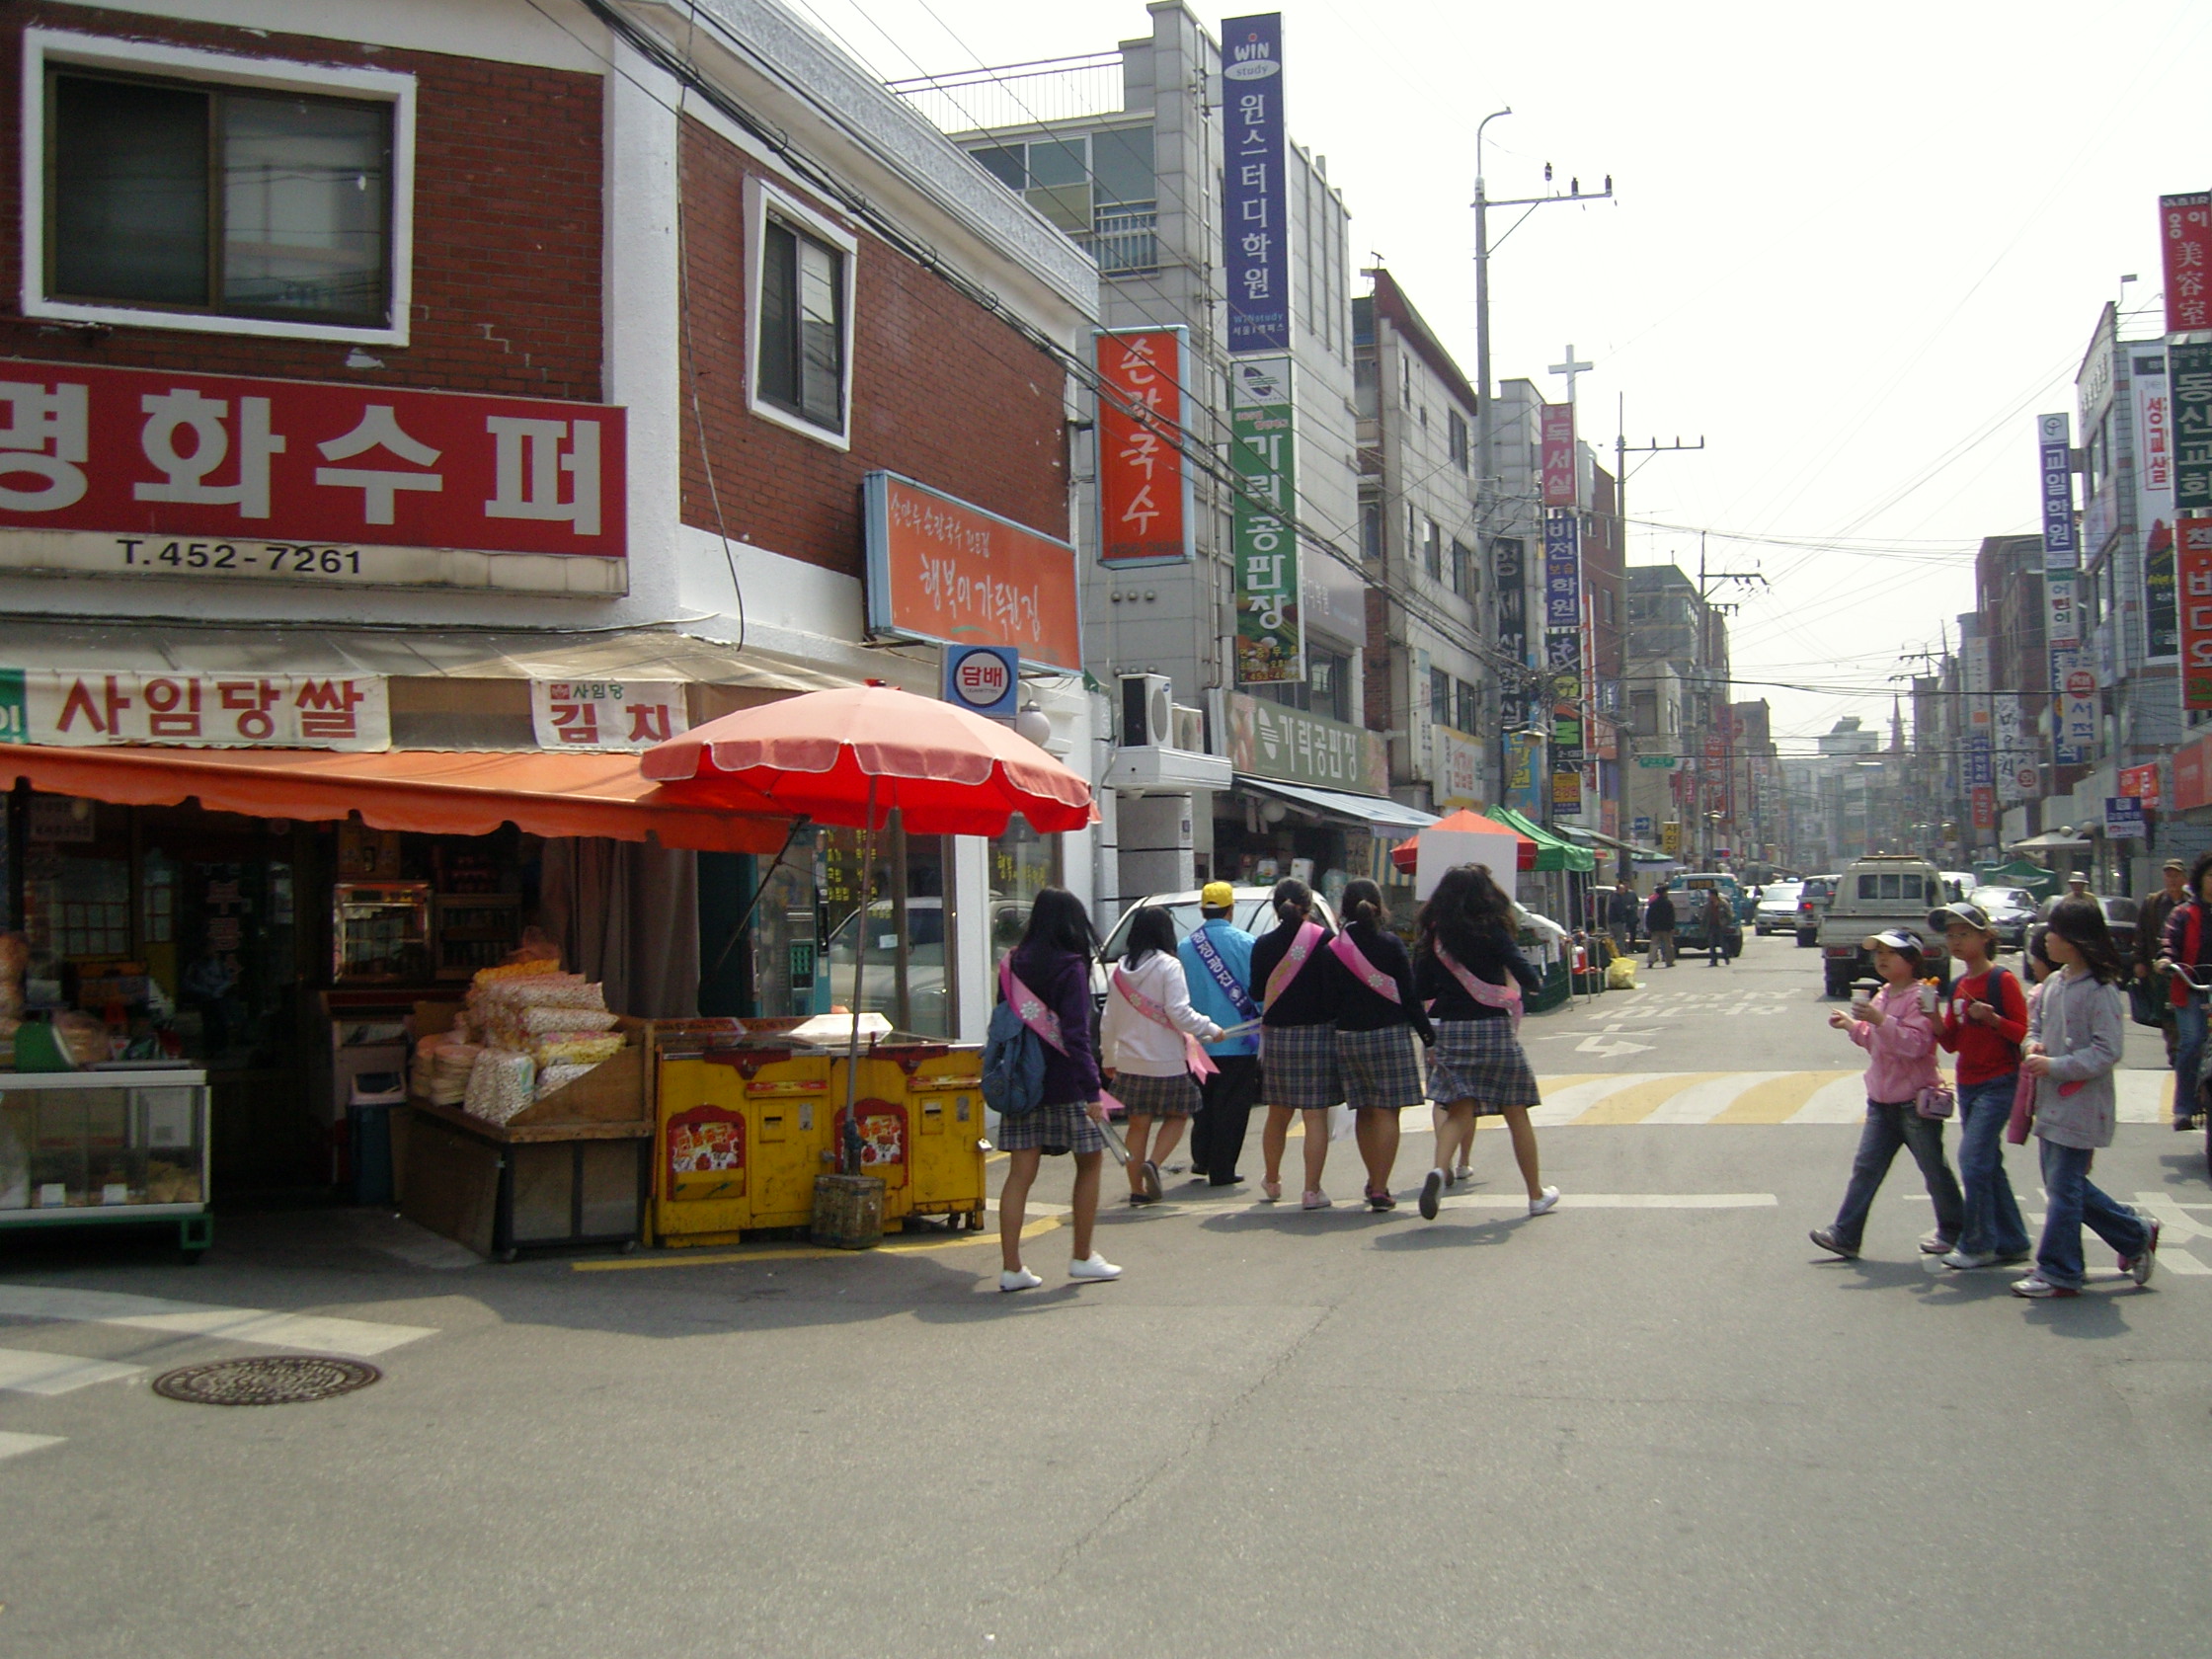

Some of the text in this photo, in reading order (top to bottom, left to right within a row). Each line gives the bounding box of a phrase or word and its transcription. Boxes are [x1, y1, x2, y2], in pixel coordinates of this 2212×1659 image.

[1236, 64, 1269, 78] study
[2175, 241, 2207, 327] 美容室
[0, 381, 601, 537] 명화수퍼
[1546, 423, 1572, 495] 독서실
[116, 538, 361, 575] T.452-7261
[1548, 520, 1575, 560] 비전
[1550, 577, 1577, 618] 학원
[573, 684, 624, 700] 사임당
[962, 667, 1003, 688] 담배
[550, 703, 672, 744] 김치
[1279, 715, 1358, 782] 가락공판장
